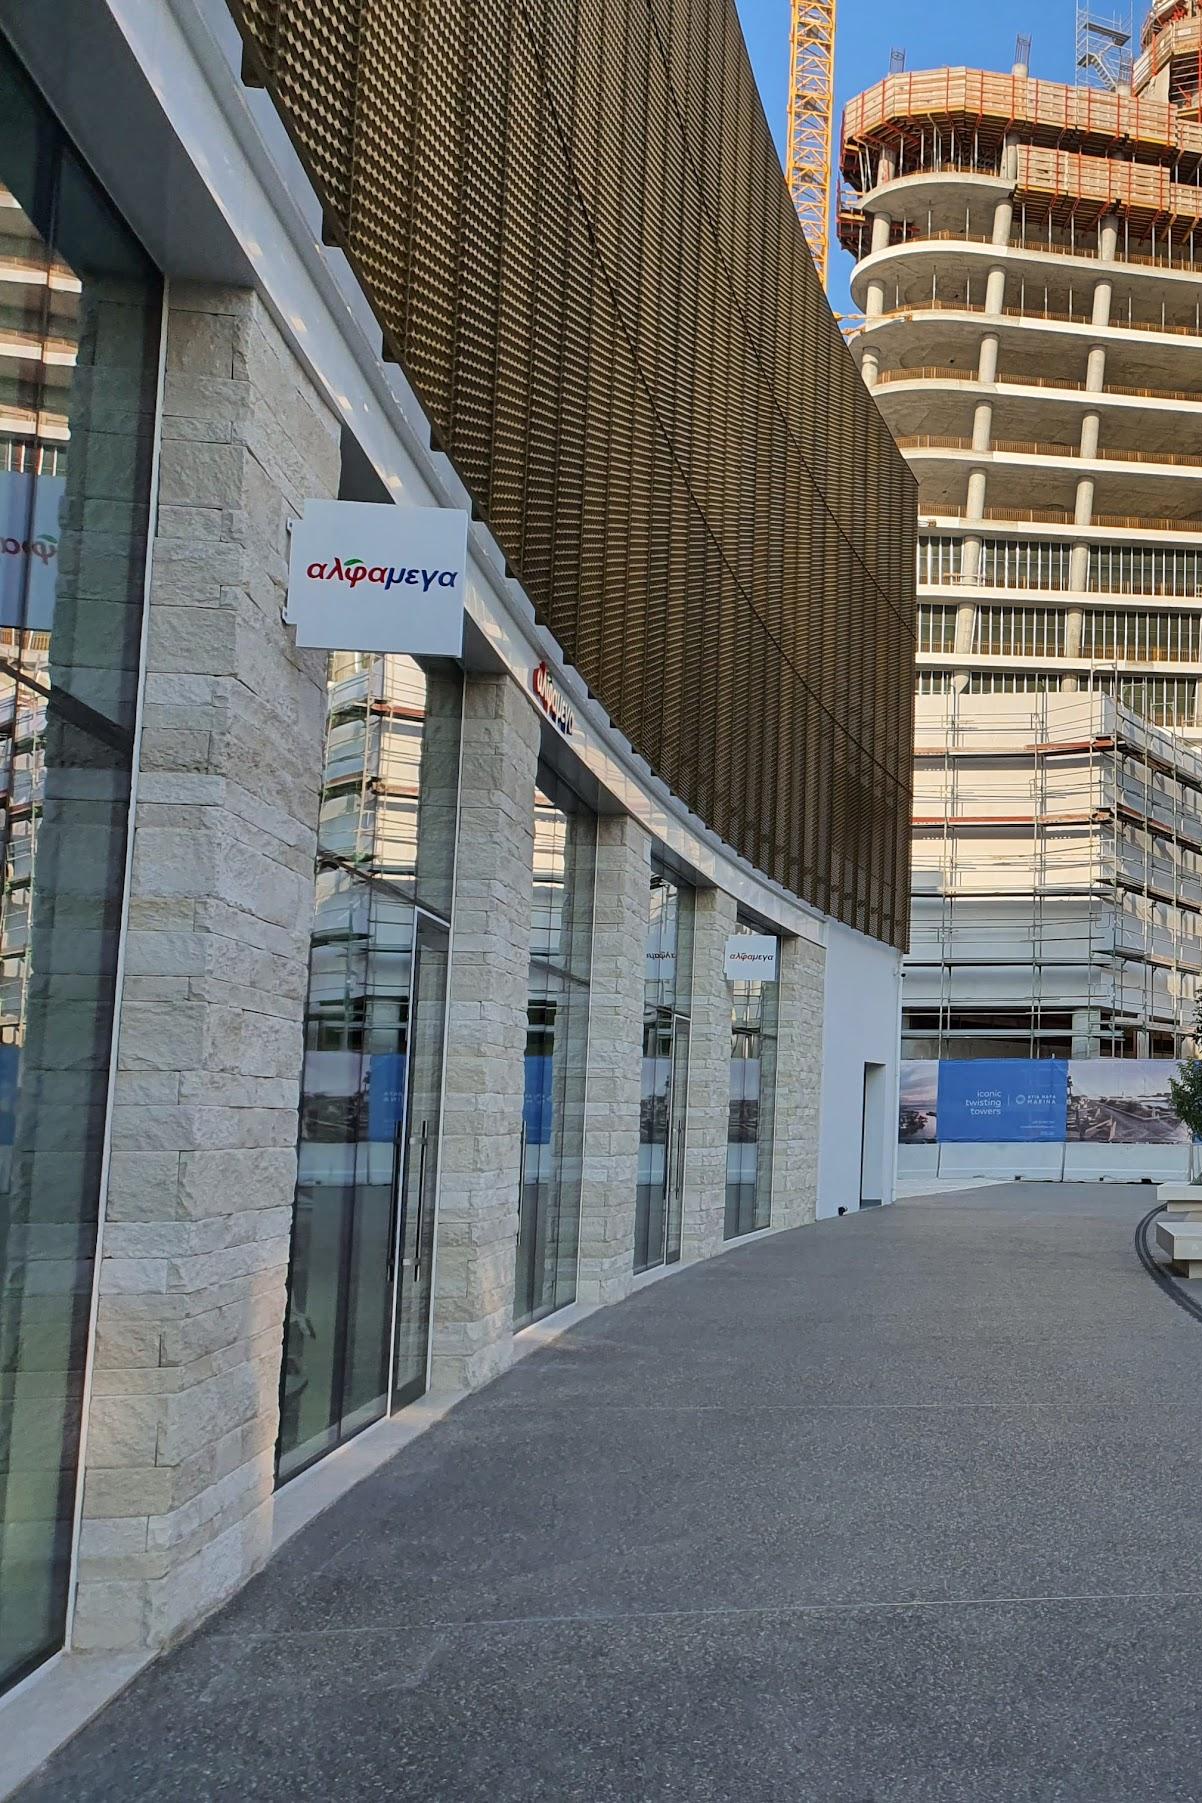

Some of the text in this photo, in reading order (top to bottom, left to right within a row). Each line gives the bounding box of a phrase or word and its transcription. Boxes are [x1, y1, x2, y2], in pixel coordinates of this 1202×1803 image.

[306, 556, 458, 592] αλφαμεγα
[729, 951, 774, 962] αλφαμεγα
[977, 1089, 1001, 1097] iconic
[965, 1098, 1001, 1108] twisting
[970, 1107, 1001, 1115] towers
